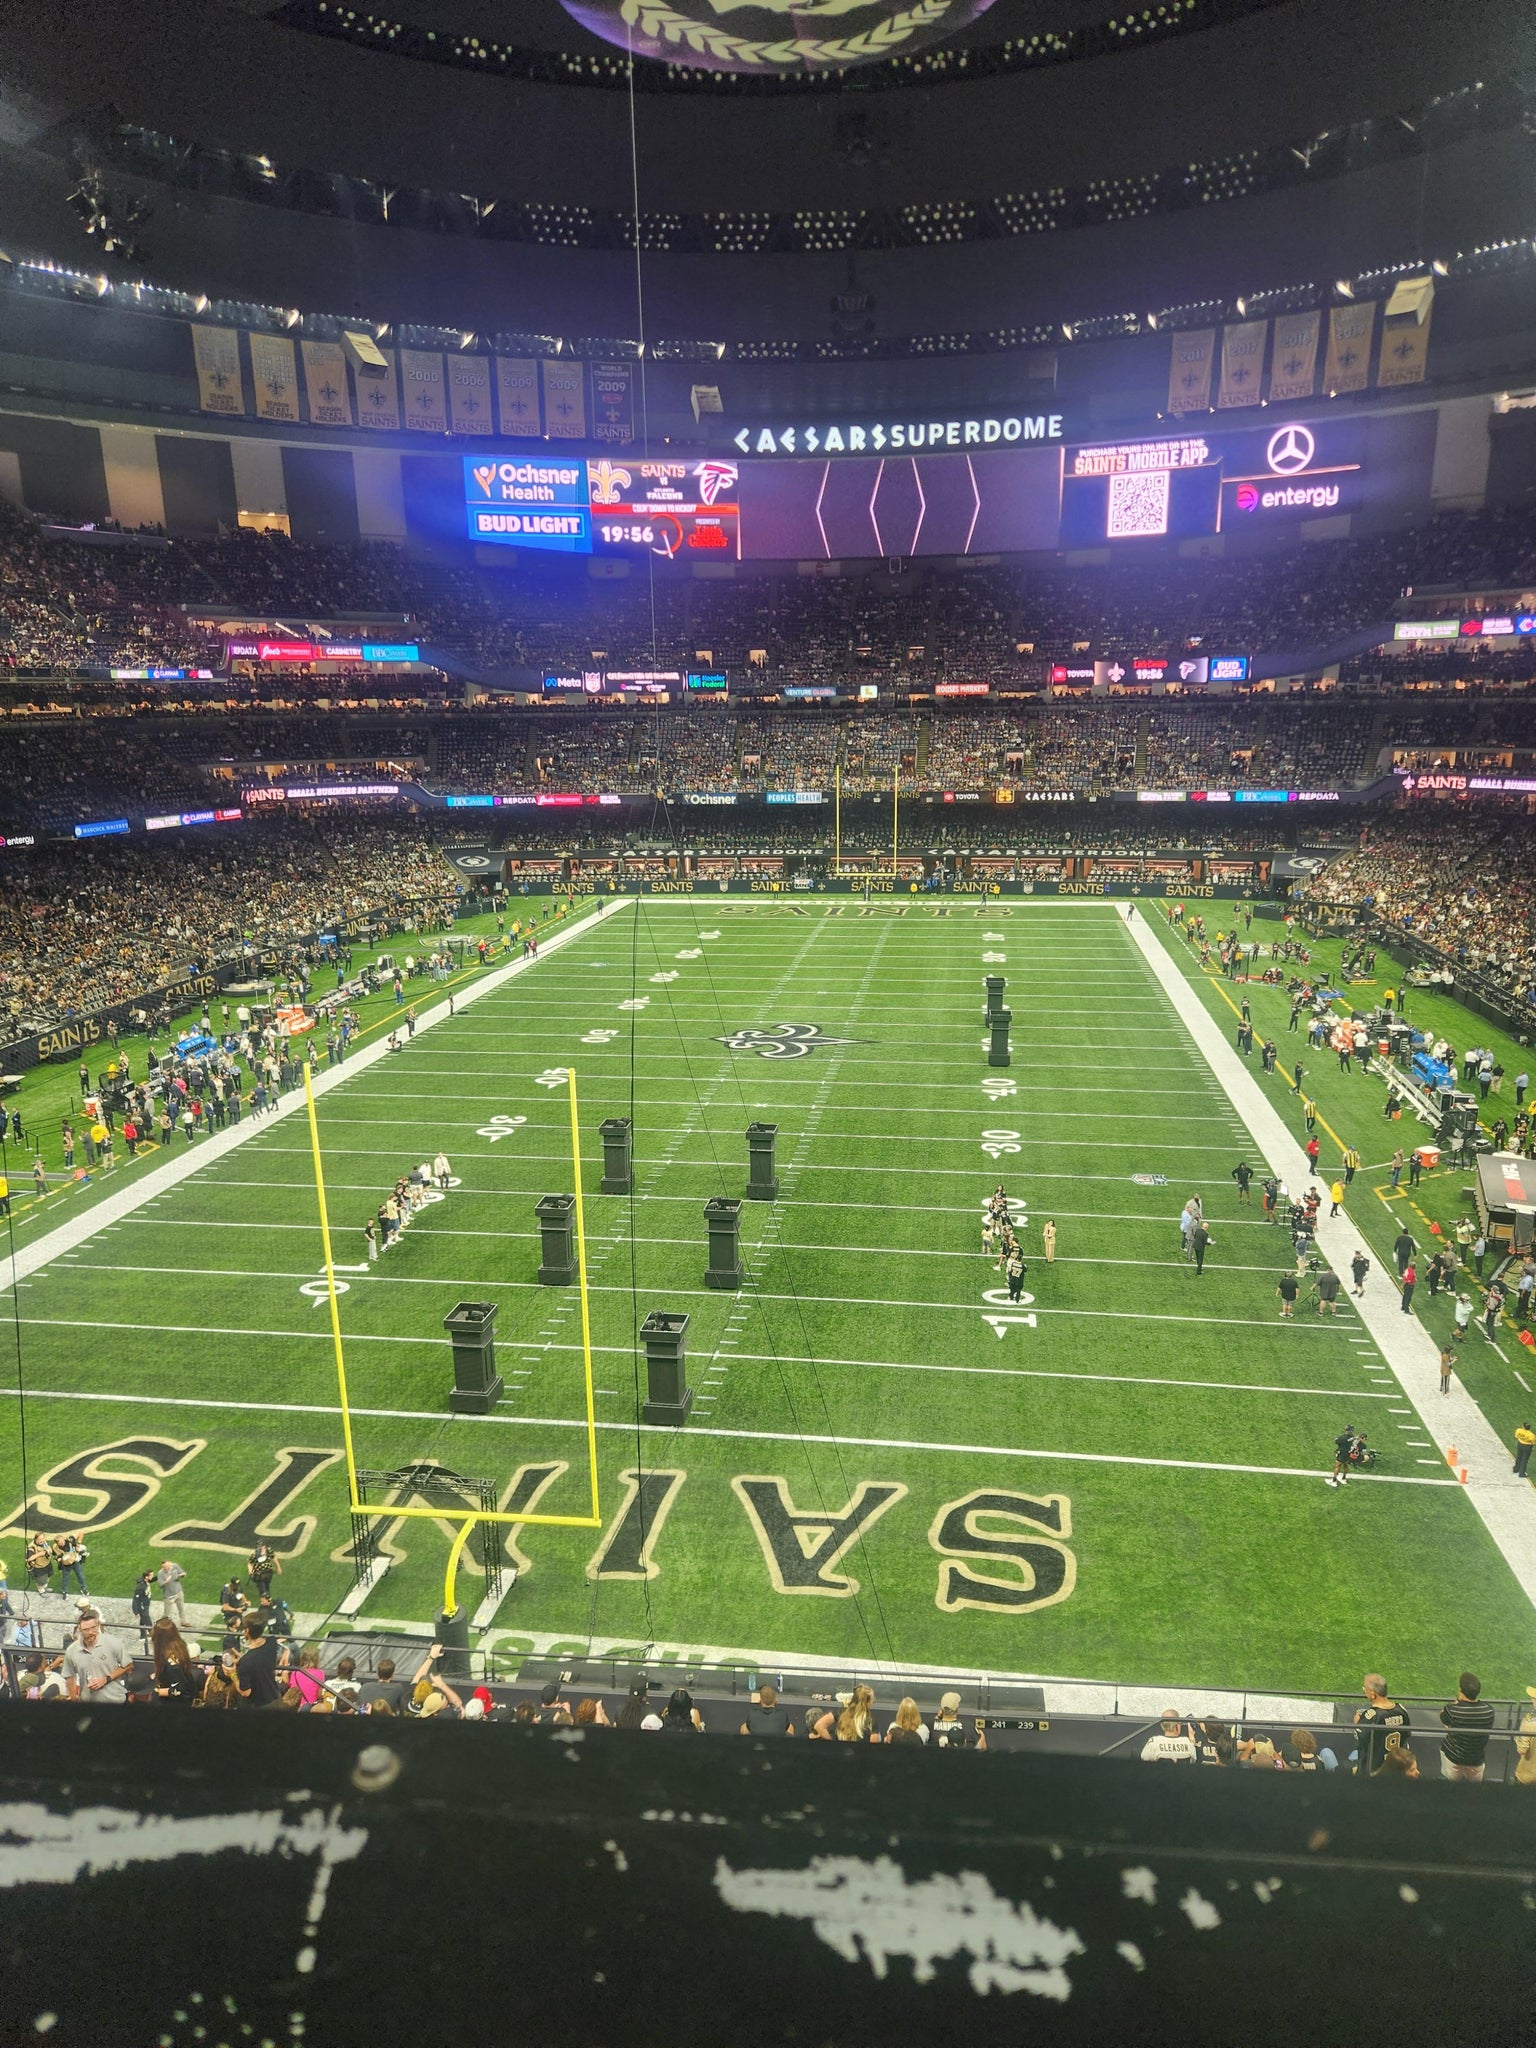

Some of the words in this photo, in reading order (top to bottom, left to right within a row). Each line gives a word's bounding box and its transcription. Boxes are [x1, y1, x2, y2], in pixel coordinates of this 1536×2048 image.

[408, 369, 439, 382] 2000
[455, 374, 485, 386] 2006
[504, 376, 532, 388] 2009
[549, 379, 578, 391] 2009
[598, 380, 626, 392] 2009
[361, 416, 397, 427] SAINTS
[408, 418, 444, 429] SAINTS
[455, 422, 490, 433] SAINTS
[503, 424, 538, 435] SAINTS
[548, 424, 584, 436] SAINTS
[596, 428, 630, 438] SAINTS
[890, 415, 1064, 448] SUPERDOME
[1079, 447, 1117, 458] PURCHASE
[1117, 445, 1142, 456] YOURS
[1142, 443, 1168, 453] ONLINE
[1189, 438, 1206, 448] THE
[1075, 454, 1127, 475] SAINTS
[1128, 449, 1179, 471] MOBILE
[1180, 446, 1209, 466] APP
[499, 463, 580, 486] Ochsner
[641, 464, 686, 478] SAINTS
[502, 484, 554, 502] Health
[646, 491, 684, 500] FALCONS
[1261, 484, 1340, 508] entergy
[478, 514, 522, 533] BUD
[523, 515, 581, 535] LIGHT
[601, 525, 654, 543] 19:56
[1217, 661, 1239, 670] BUD
[1067, 669, 1094, 678] TOYOTA
[1136, 669, 1164, 680] 19:56
[1213, 669, 1242, 678] LIGHT
[557, 677, 582, 688] Meta
[785, 688, 811, 697] VENTURE
[1417, 775, 1467, 790] SAINTS
[1469, 778, 1502, 789] SMALL
[249, 788, 285, 803] SAINTS
[287, 789, 316, 798] SMALL
[316, 787, 356, 796] BUSINESS
[357, 785, 399, 795] PARTNERS
[690, 794, 737, 805] Ochsner
[768, 793, 795, 802] PEOPLES
[998, 789, 1012, 802] 25
[1025, 792, 1075, 801] CAESARS
[1083, 790, 1111, 798] SAINTS
[1299, 792, 1340, 800] REPDATA
[503, 797, 536, 805] REPDATA
[6, 834, 35, 846] entergy
[1034, 849, 1157, 857] SUPERDOME
[552, 882, 595, 894] SAINTS
[651, 881, 694, 893] SAINTS
[952, 881, 998, 893] SAINTS
[1058, 882, 1105, 895] SAINTS
[1165, 884, 1214, 898] SAINTS
[715, 905, 1014, 917] SAINTS
[38, 1018, 100, 1060] SAINTS
[581, 1028, 619, 1043] 50
[981, 1078, 1018, 1097] 40
[476, 1115, 527, 1137] 30
[981, 1129, 1022, 1153] 30
[299, 1261, 371, 1297] 10
[981, 1288, 1037, 1328] 10
[0, 1436, 1077, 1615] SAINTS
[991, 1720, 1007, 1729] 241
[1017, 1721, 1035, 1730] 239
[1159, 1742, 1189, 1753] GLEASON
